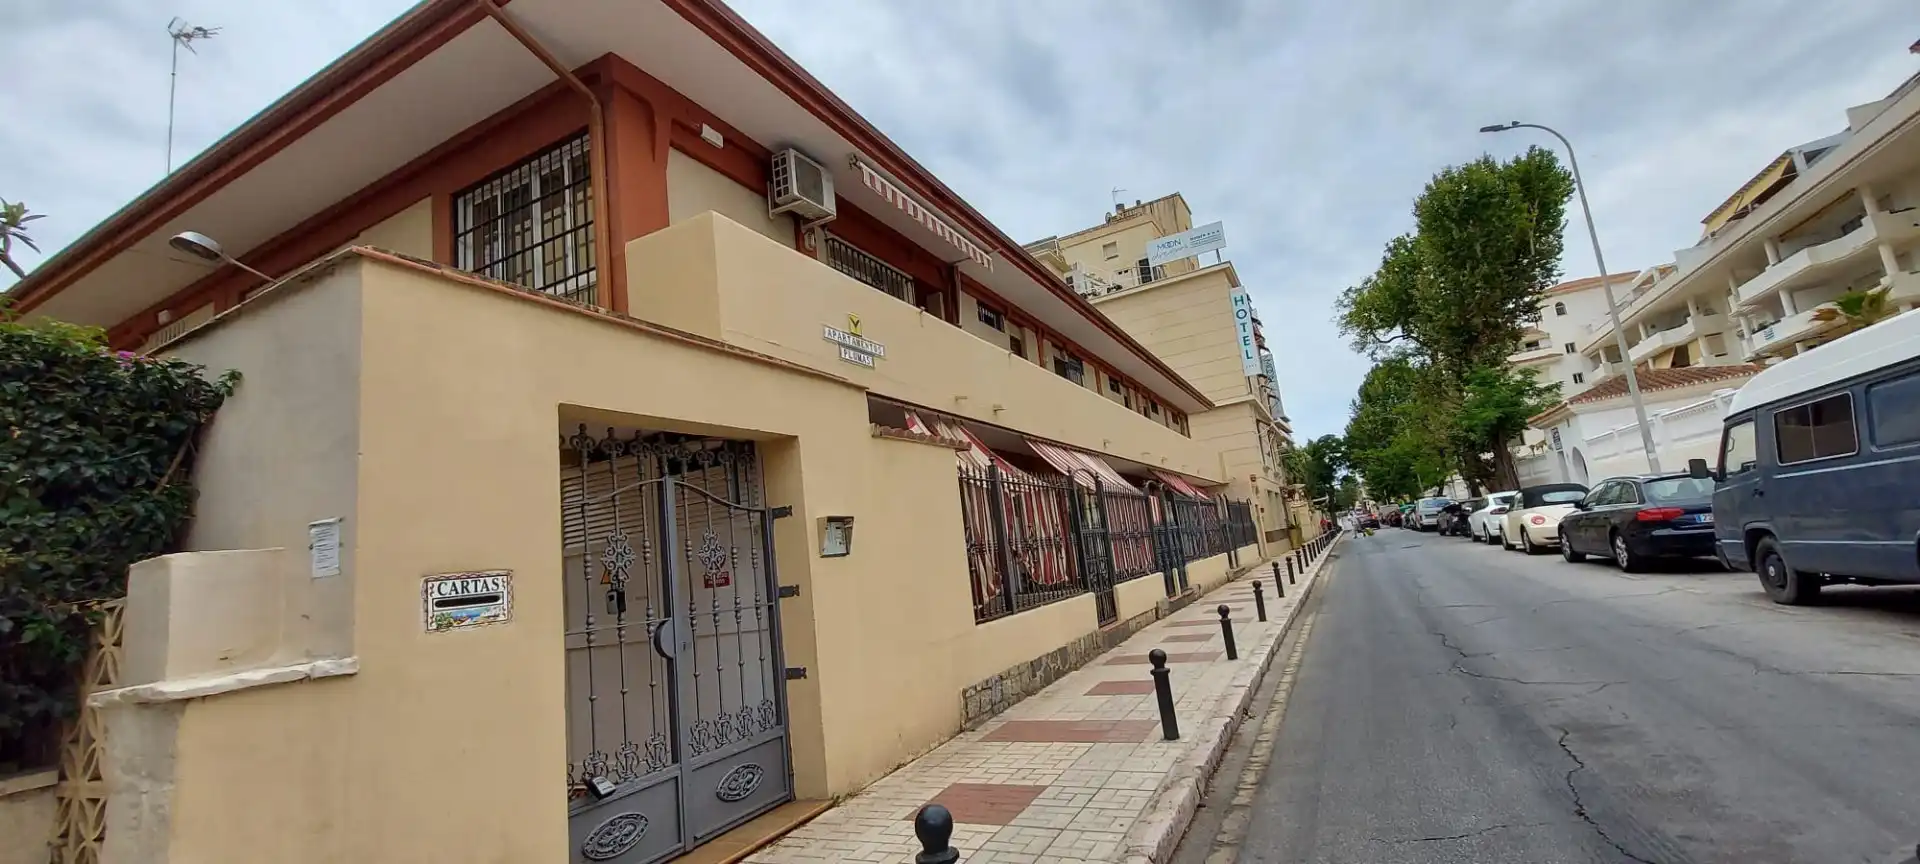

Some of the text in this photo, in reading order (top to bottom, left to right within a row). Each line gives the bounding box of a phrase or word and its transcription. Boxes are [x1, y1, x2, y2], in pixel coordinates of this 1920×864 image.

[1234, 296, 1253, 360] HOTEL
[844, 349, 870, 364] PLUMAS
[437, 578, 499, 596] CARTAS
